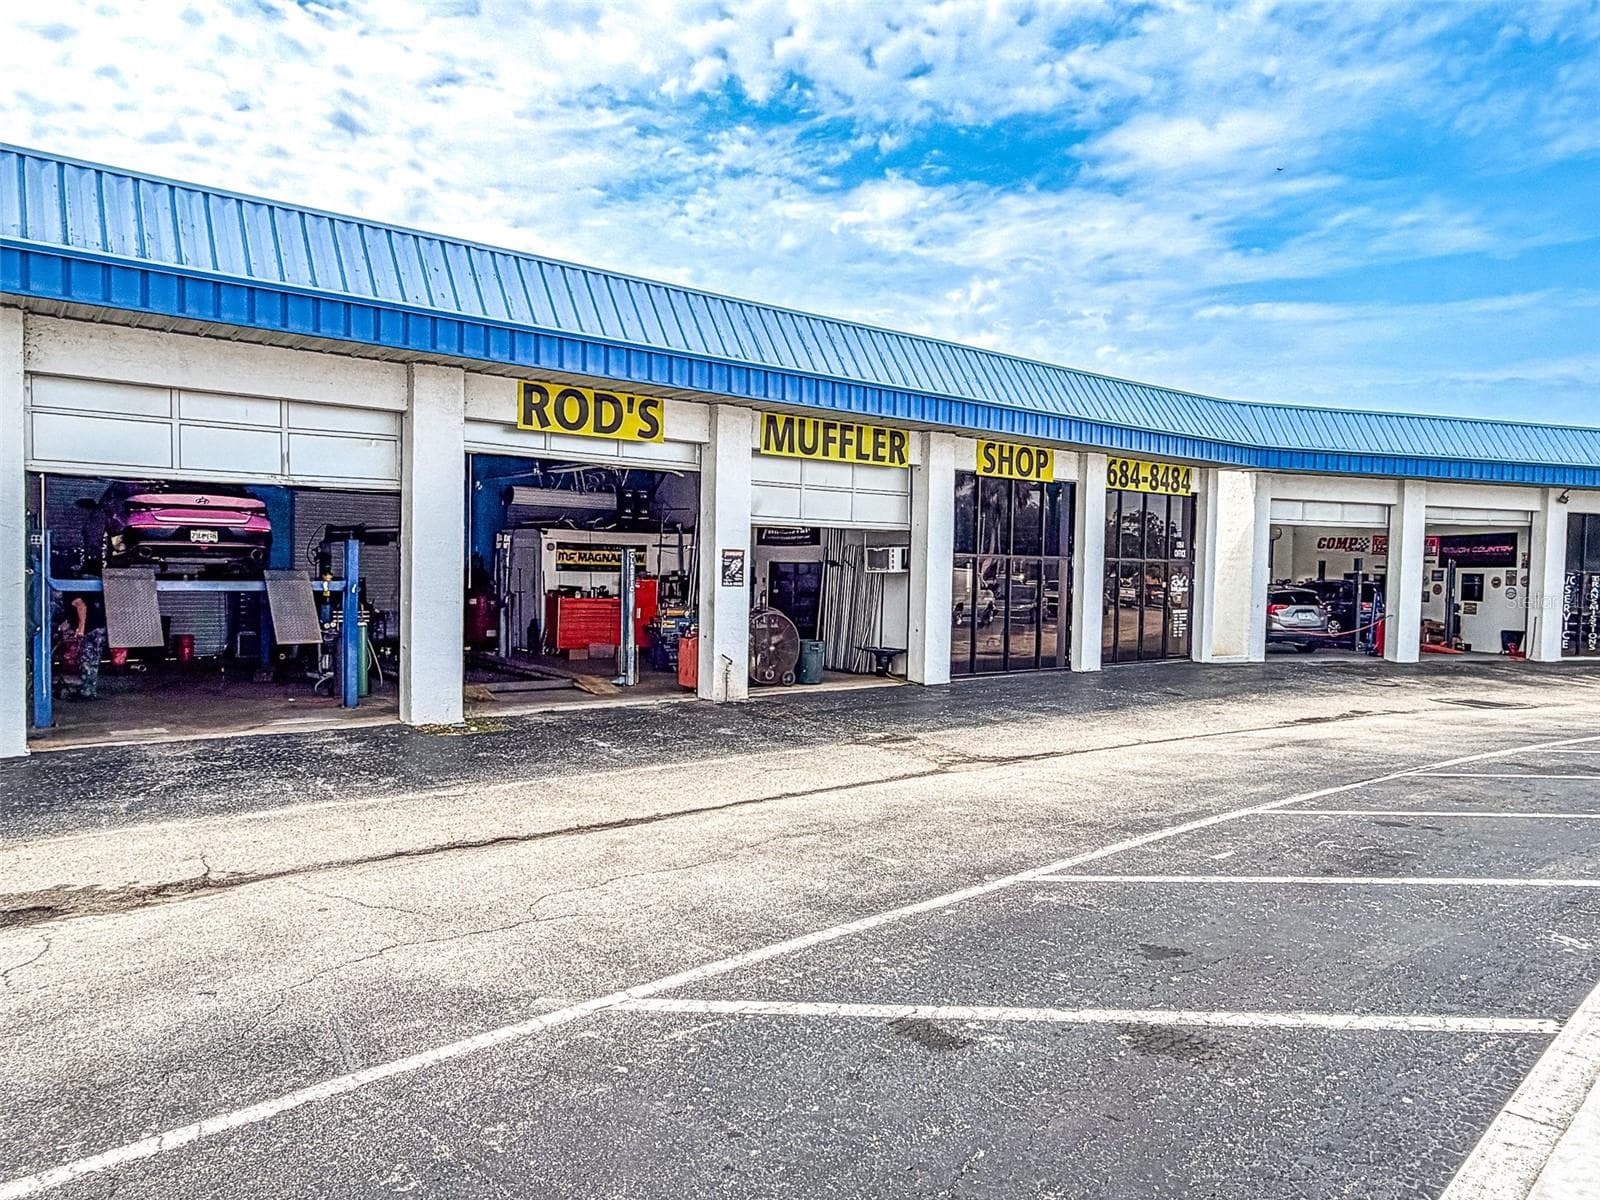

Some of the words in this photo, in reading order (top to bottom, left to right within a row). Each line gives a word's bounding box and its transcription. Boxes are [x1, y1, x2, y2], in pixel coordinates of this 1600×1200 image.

[521, 382, 661, 440] ROD'S
[763, 414, 907, 466] MUFFLER
[982, 441, 1050, 480] SHOP
[1106, 459, 1192, 494] 684-8484
